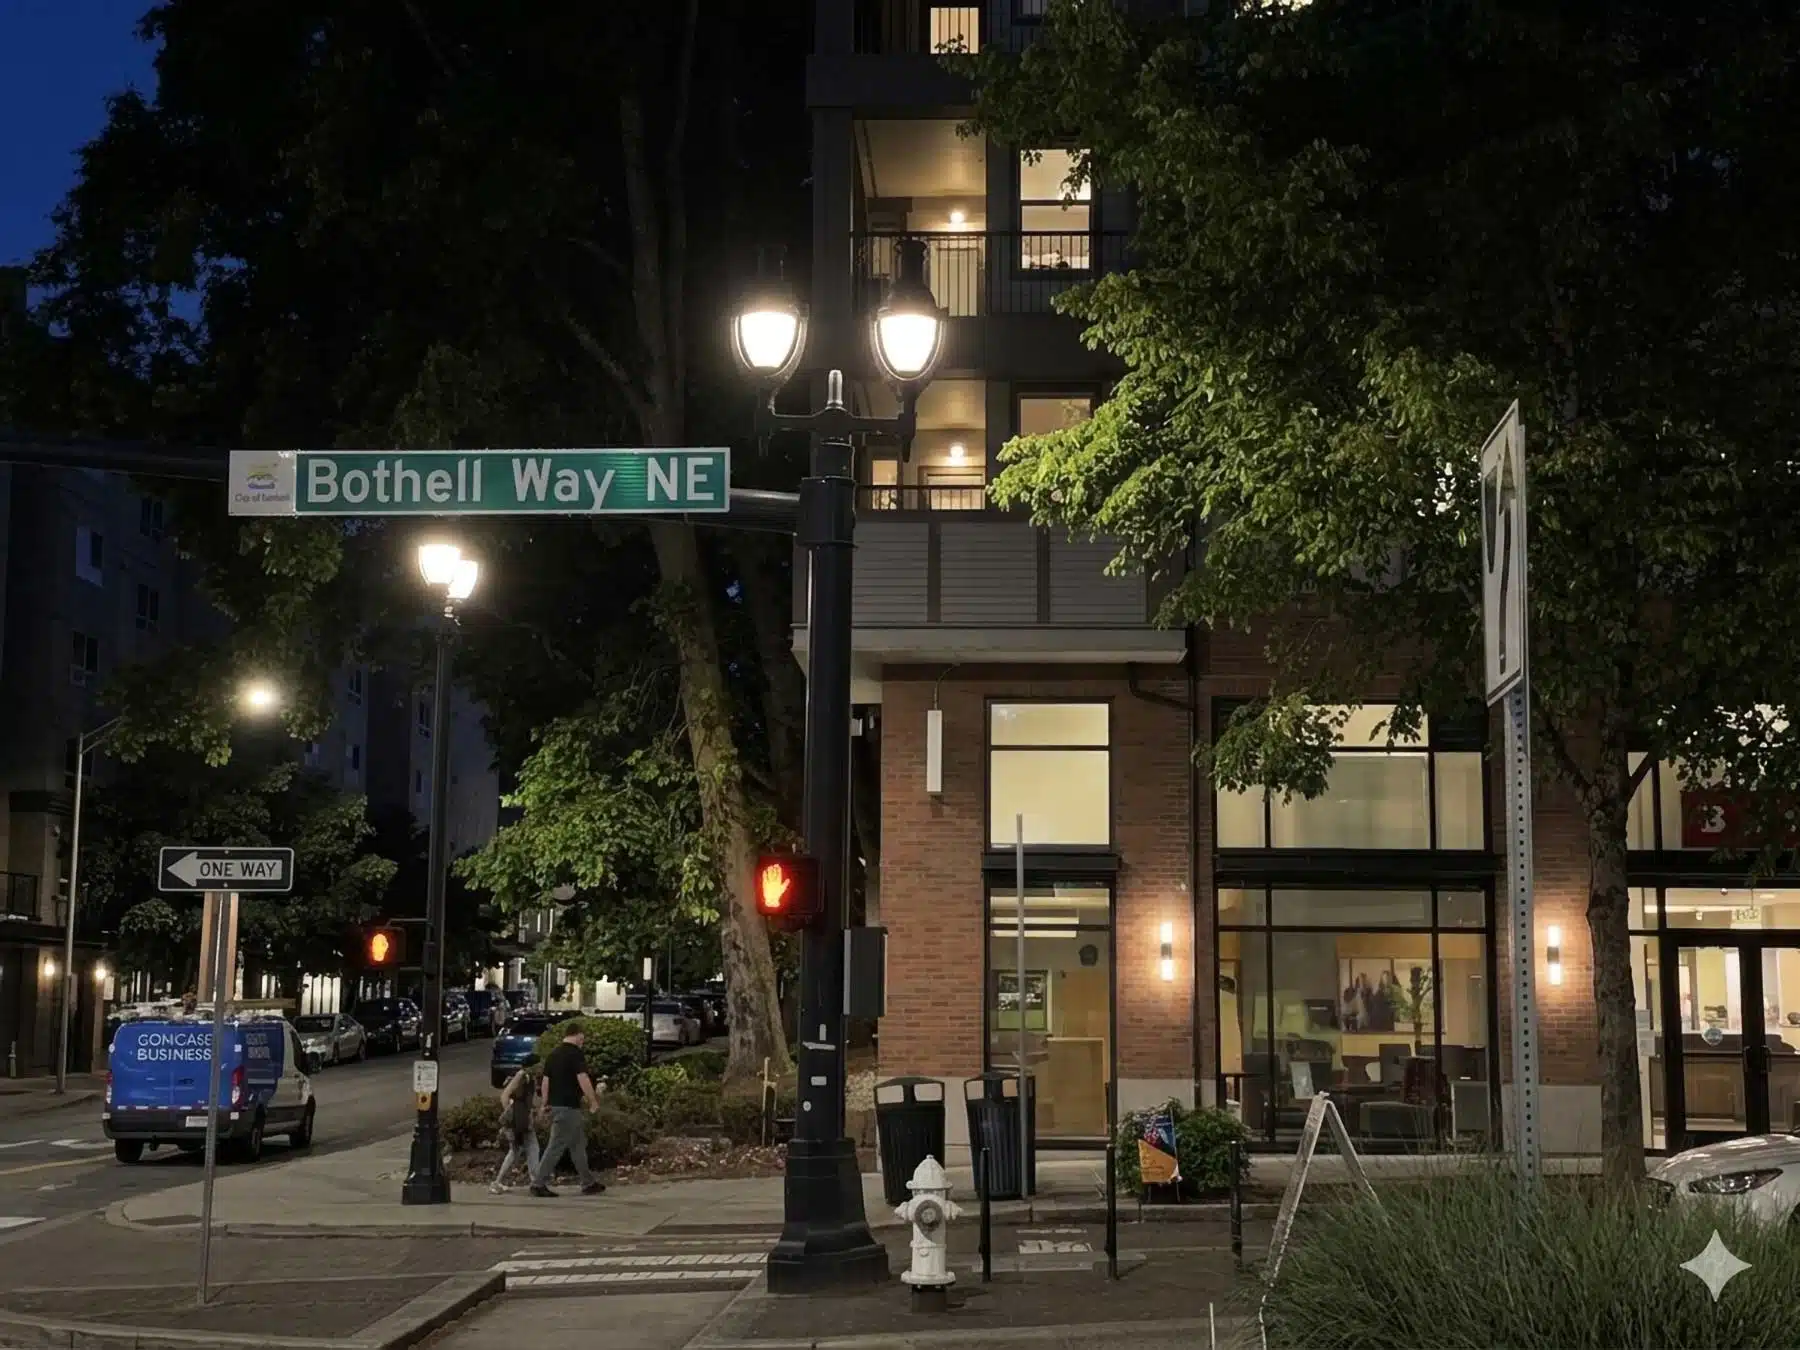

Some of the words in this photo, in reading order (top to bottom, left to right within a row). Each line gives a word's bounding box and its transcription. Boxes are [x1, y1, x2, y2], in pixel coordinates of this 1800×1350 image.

[307, 457, 483, 503] Bothell
[512, 457, 616, 513] Way
[647, 456, 714, 502] NE
[200, 862, 235, 877] ONE
[240, 862, 277, 877] WAY
